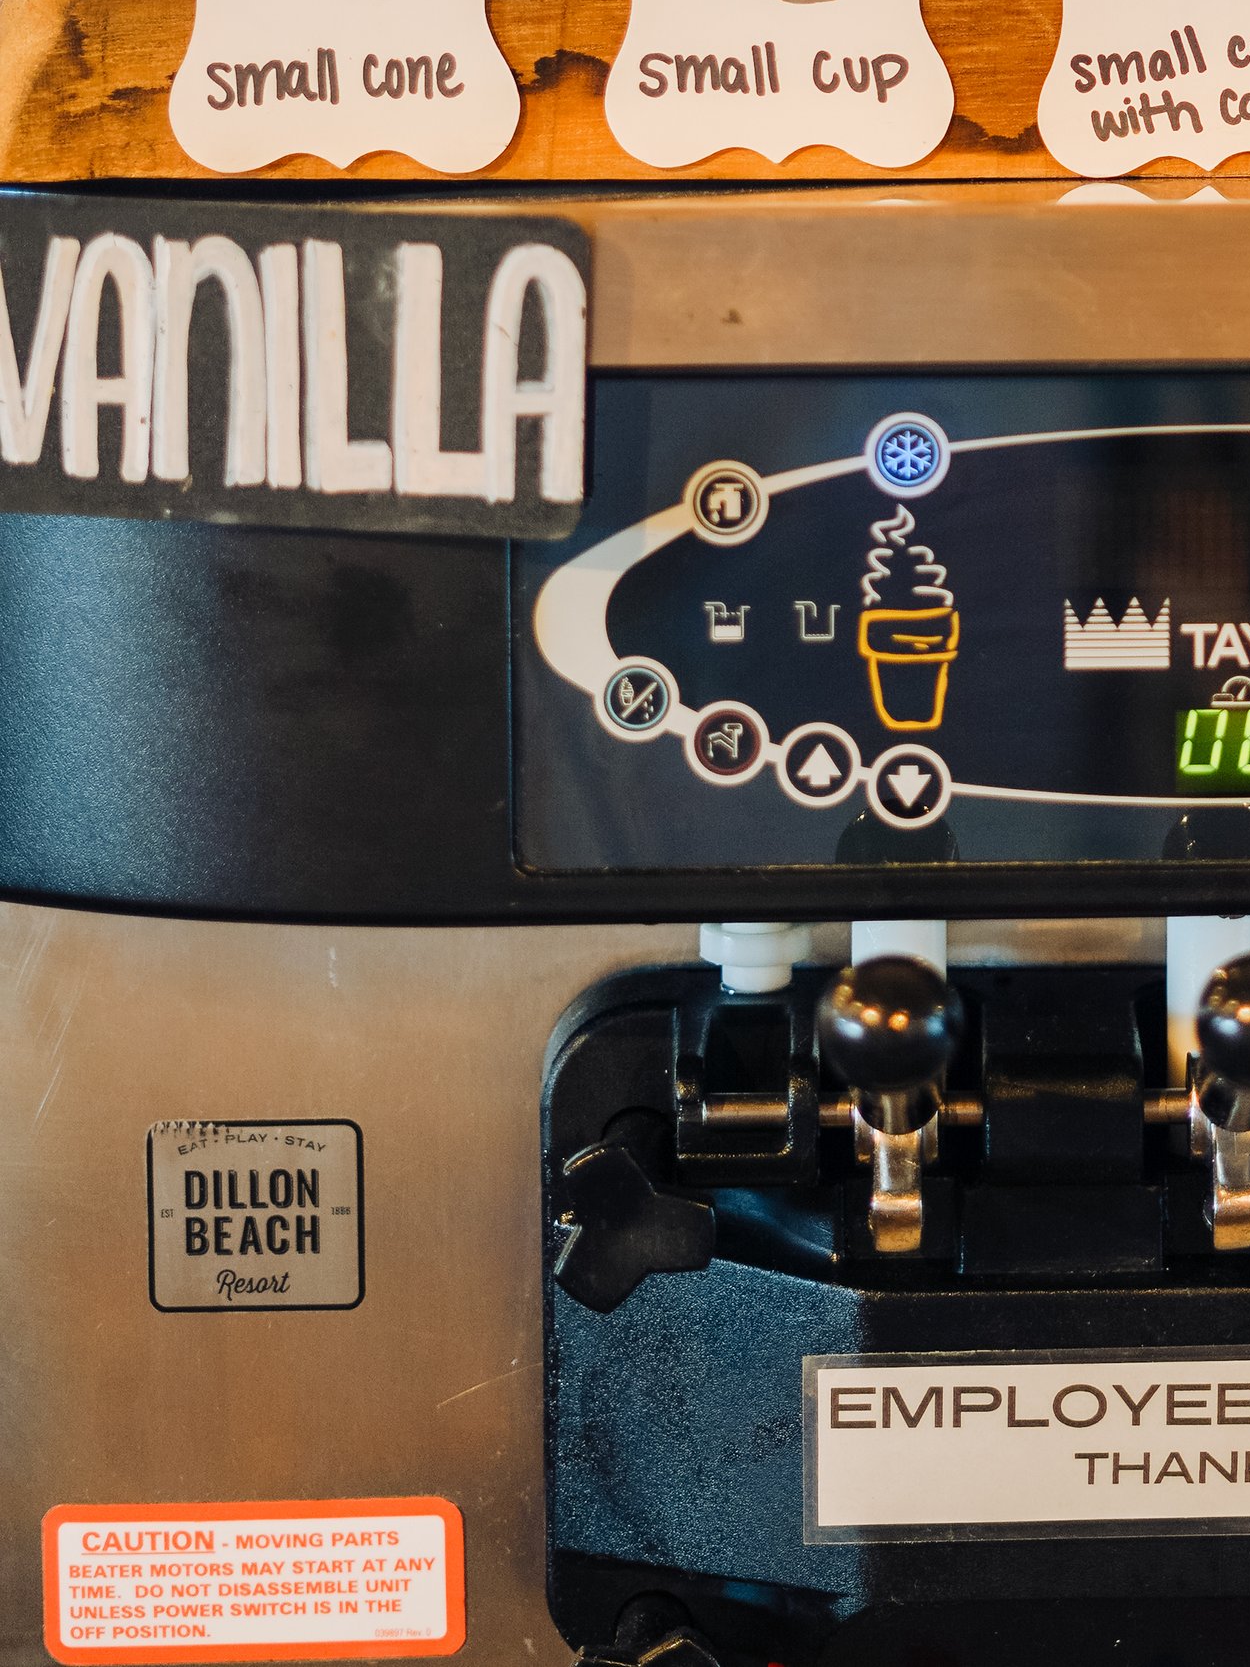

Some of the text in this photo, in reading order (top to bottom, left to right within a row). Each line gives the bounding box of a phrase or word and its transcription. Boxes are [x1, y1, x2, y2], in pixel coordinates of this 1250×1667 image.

[639, 41, 780, 98] small
[1070, 25, 1207, 93] small
[207, 47, 465, 111] small cone
[1091, 90, 1204, 142] with
[0, 232, 587, 504] VANILLA
[177, 1133, 327, 1156] EAT PLAY STAY
[184, 1168, 320, 1210] DILLON
[185, 1214, 321, 1256] BEACH
[216, 1269, 291, 1301] Resort
[81, 1530, 400, 1553] CAUTION MOVING PARTS
[69, 1557, 435, 1579] BEATER MOTORS MAY START AT ANY
[69, 1578, 412, 1599] TIME. DO NOT DISASSEMBLE UNIT
[70, 1599, 402, 1620] UNLESS POWER SWITCH IS IN THE
[70, 1624, 211, 1640] OFF POSITION.
